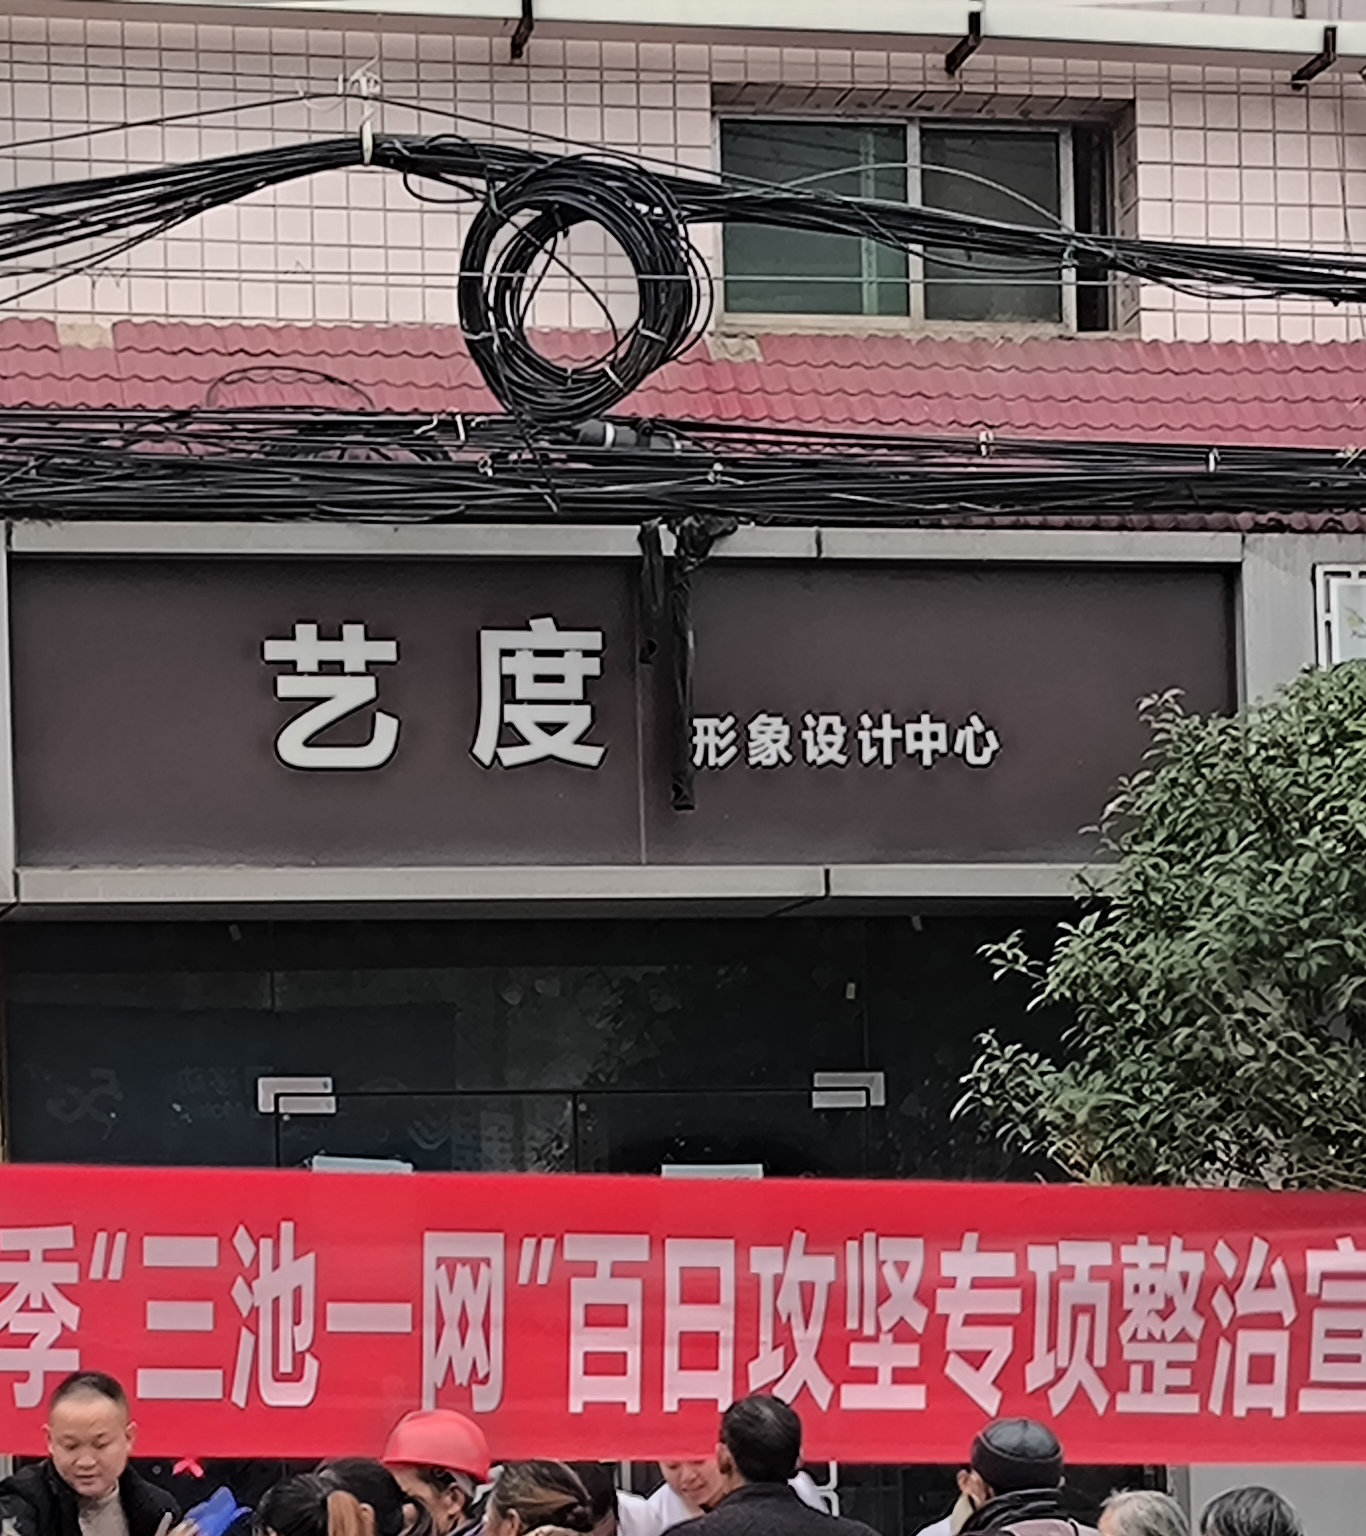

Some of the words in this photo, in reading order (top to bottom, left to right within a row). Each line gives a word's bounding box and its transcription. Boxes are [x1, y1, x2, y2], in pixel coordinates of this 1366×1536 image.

[262, 617, 607, 770] 艺度
[692, 714, 1000, 768] 形象设计中心
